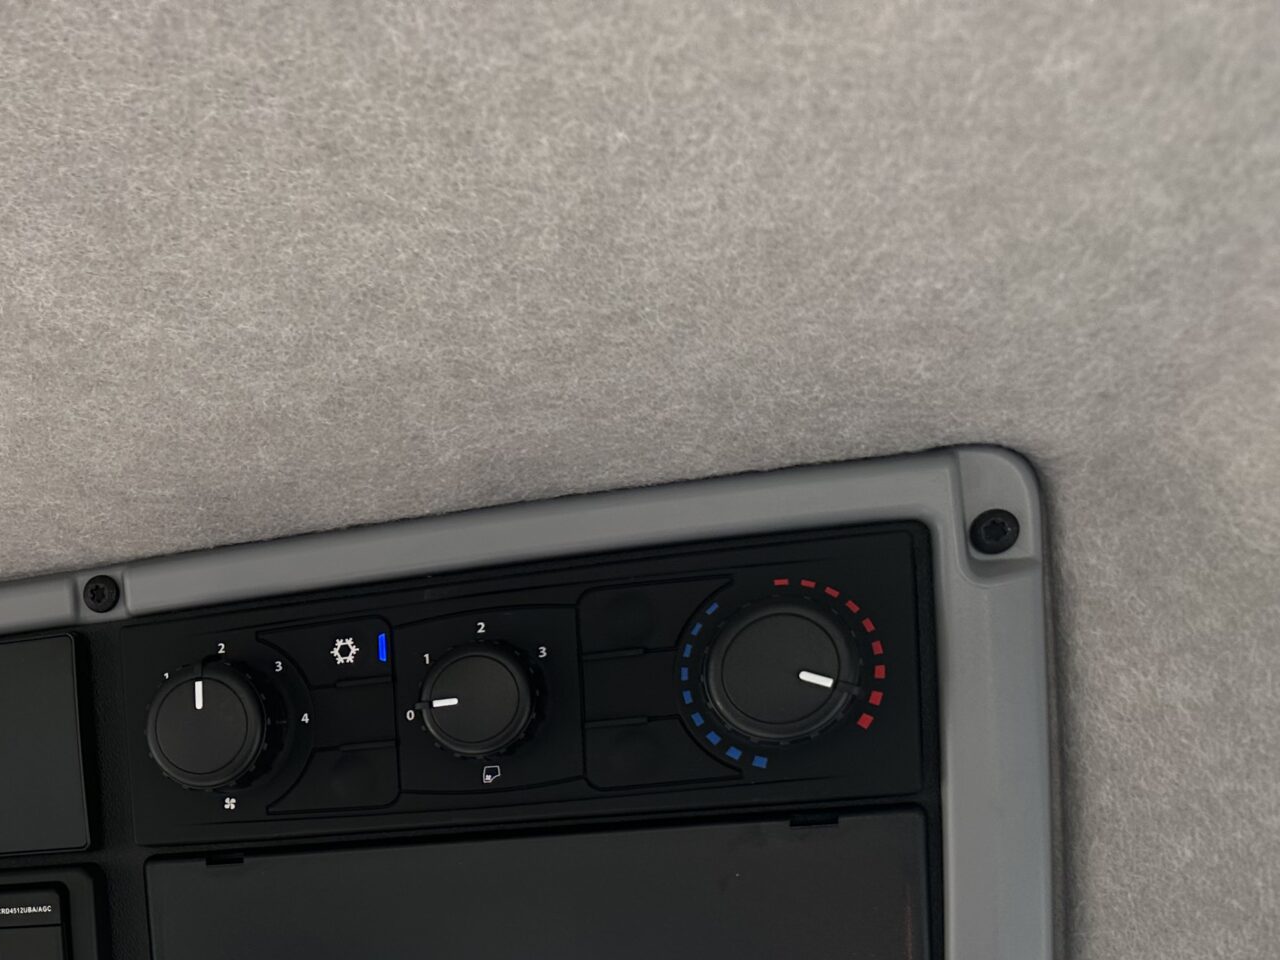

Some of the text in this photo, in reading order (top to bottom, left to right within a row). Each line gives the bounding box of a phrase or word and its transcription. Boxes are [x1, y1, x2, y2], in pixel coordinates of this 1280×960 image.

[477, 621, 486, 633] 2
[217, 642, 226, 654] 2
[538, 646, 547, 658] 3
[423, 653, 430, 665] 1
[274, 660, 283, 672] 3
[301, 713, 309, 724] 4
[406, 709, 415, 721] 0
